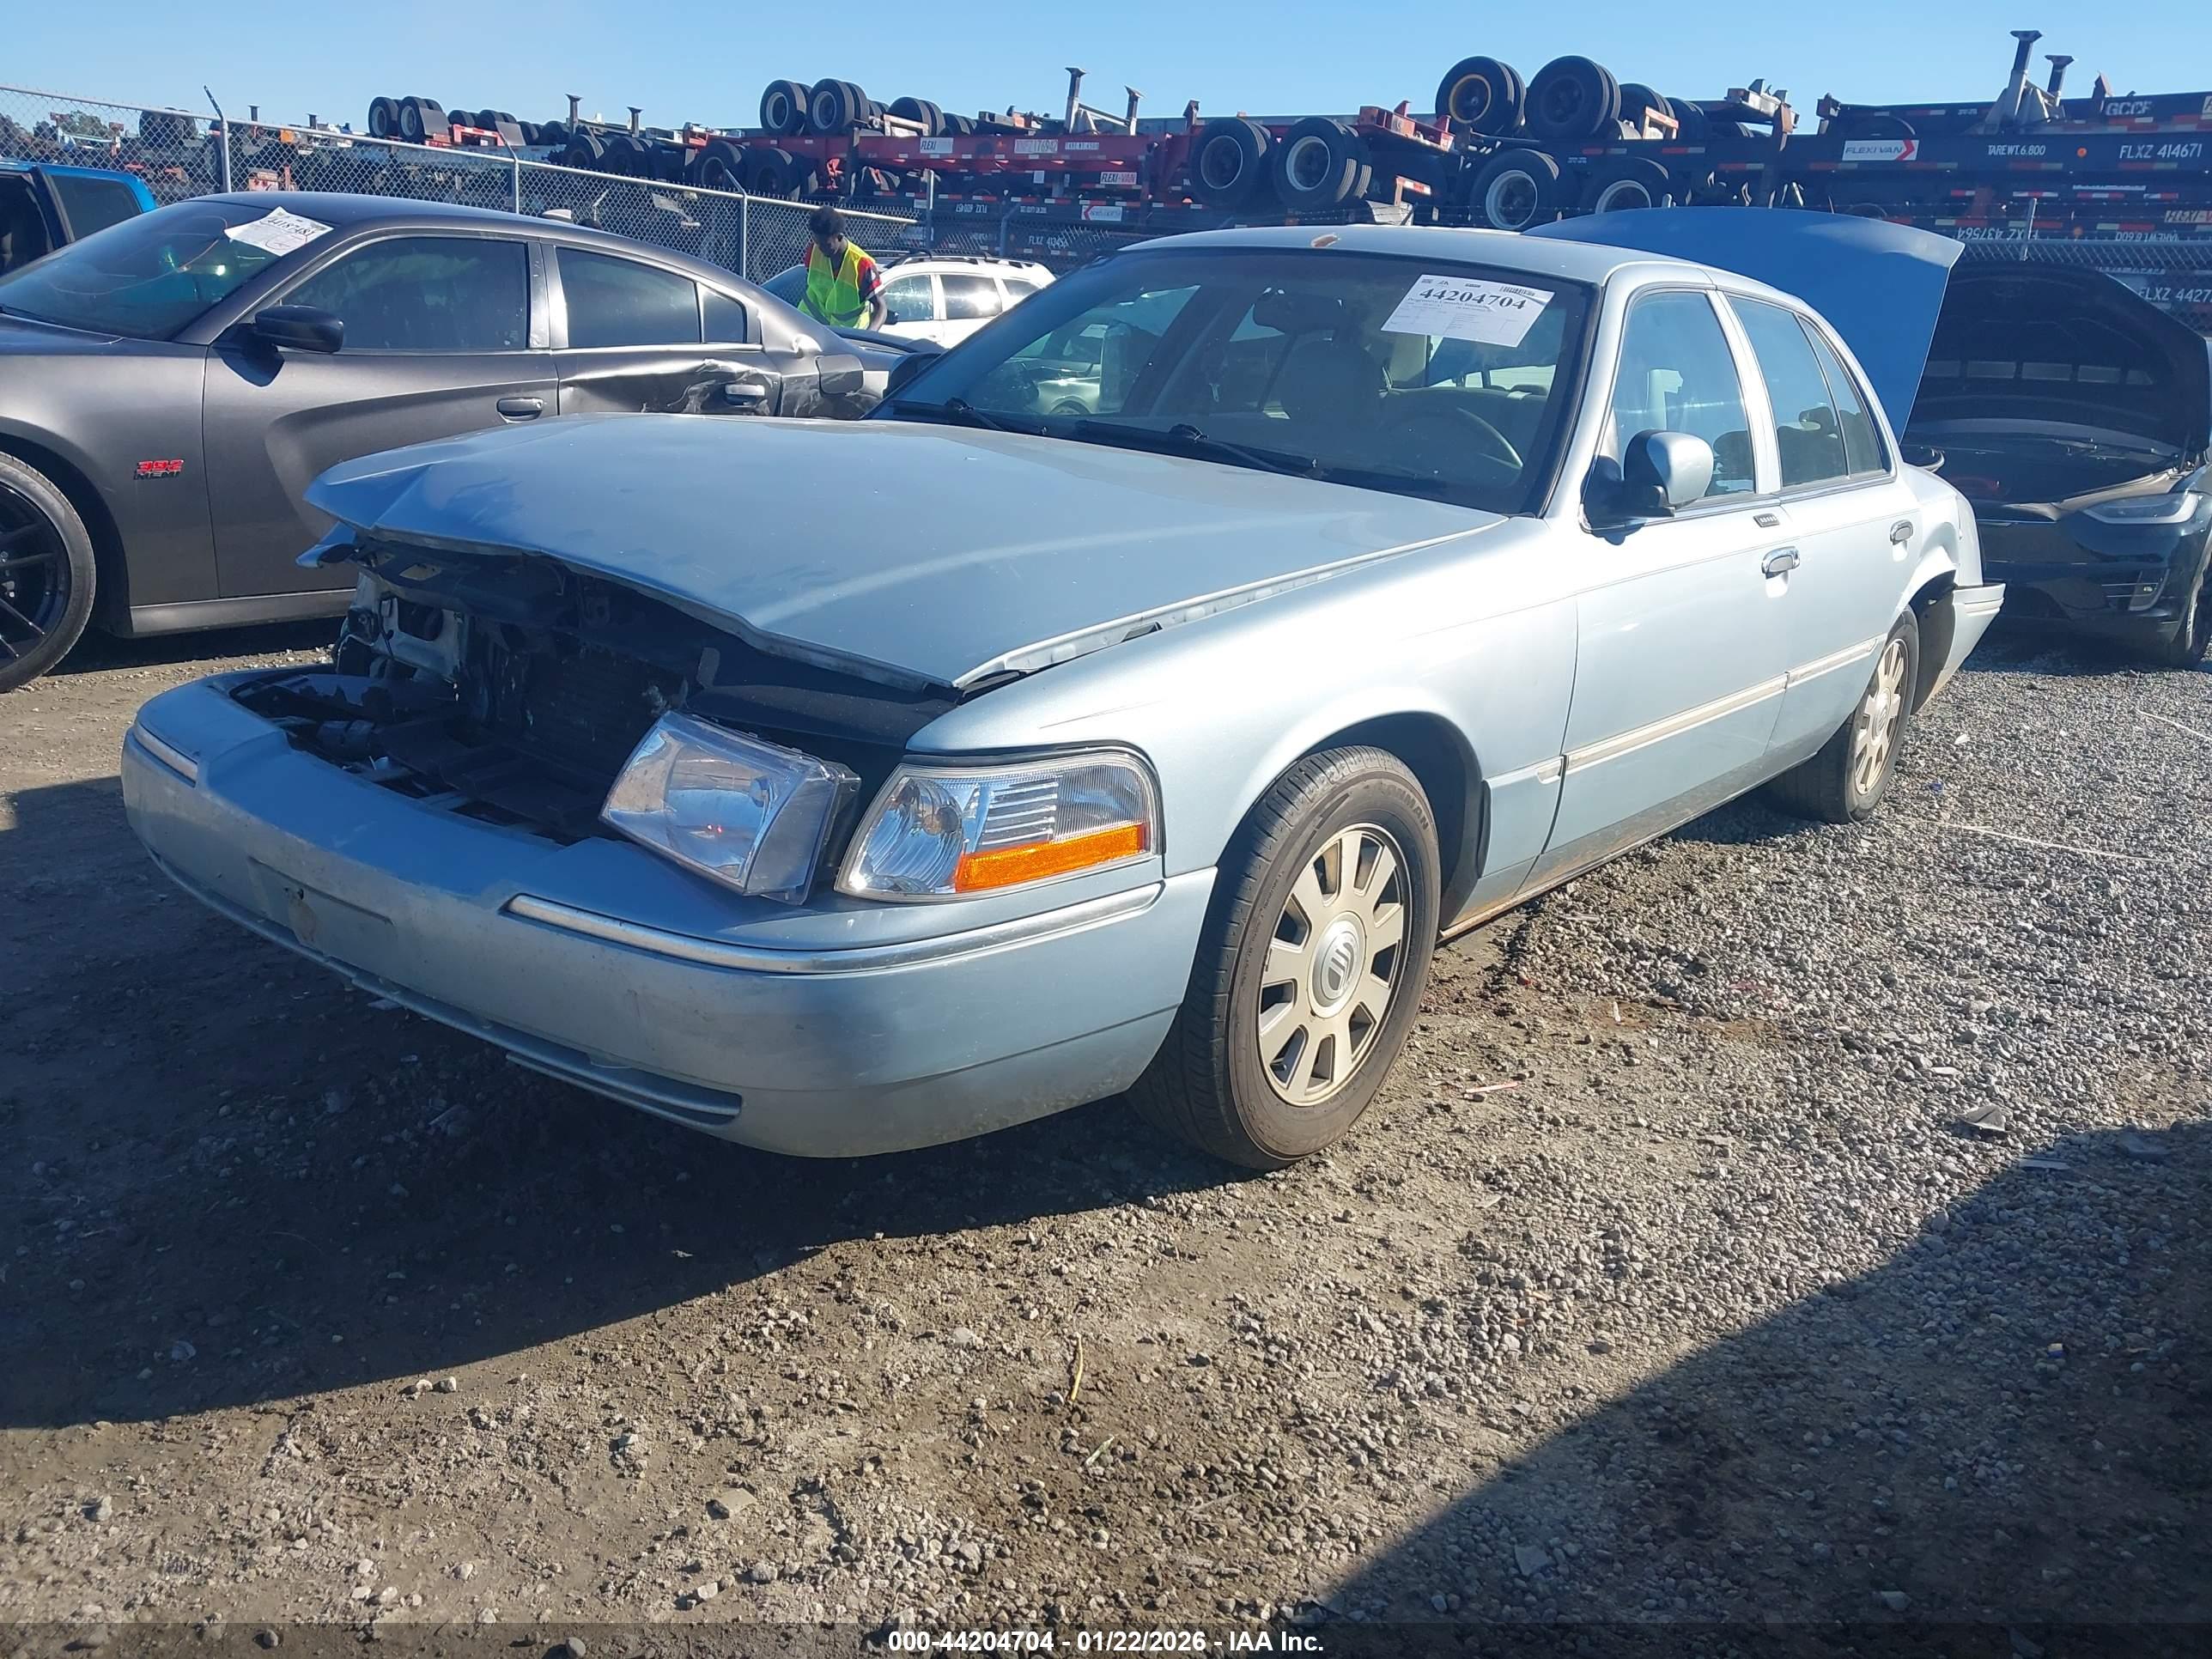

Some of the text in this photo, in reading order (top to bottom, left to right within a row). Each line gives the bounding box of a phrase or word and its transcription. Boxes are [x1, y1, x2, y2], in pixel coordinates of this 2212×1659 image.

[2119, 143, 2203, 159] FLXZ 414671
[1419, 288, 1528, 310] 44204704
[2138, 287, 2172, 301] FLXZ
[137, 459, 184, 474] 392
